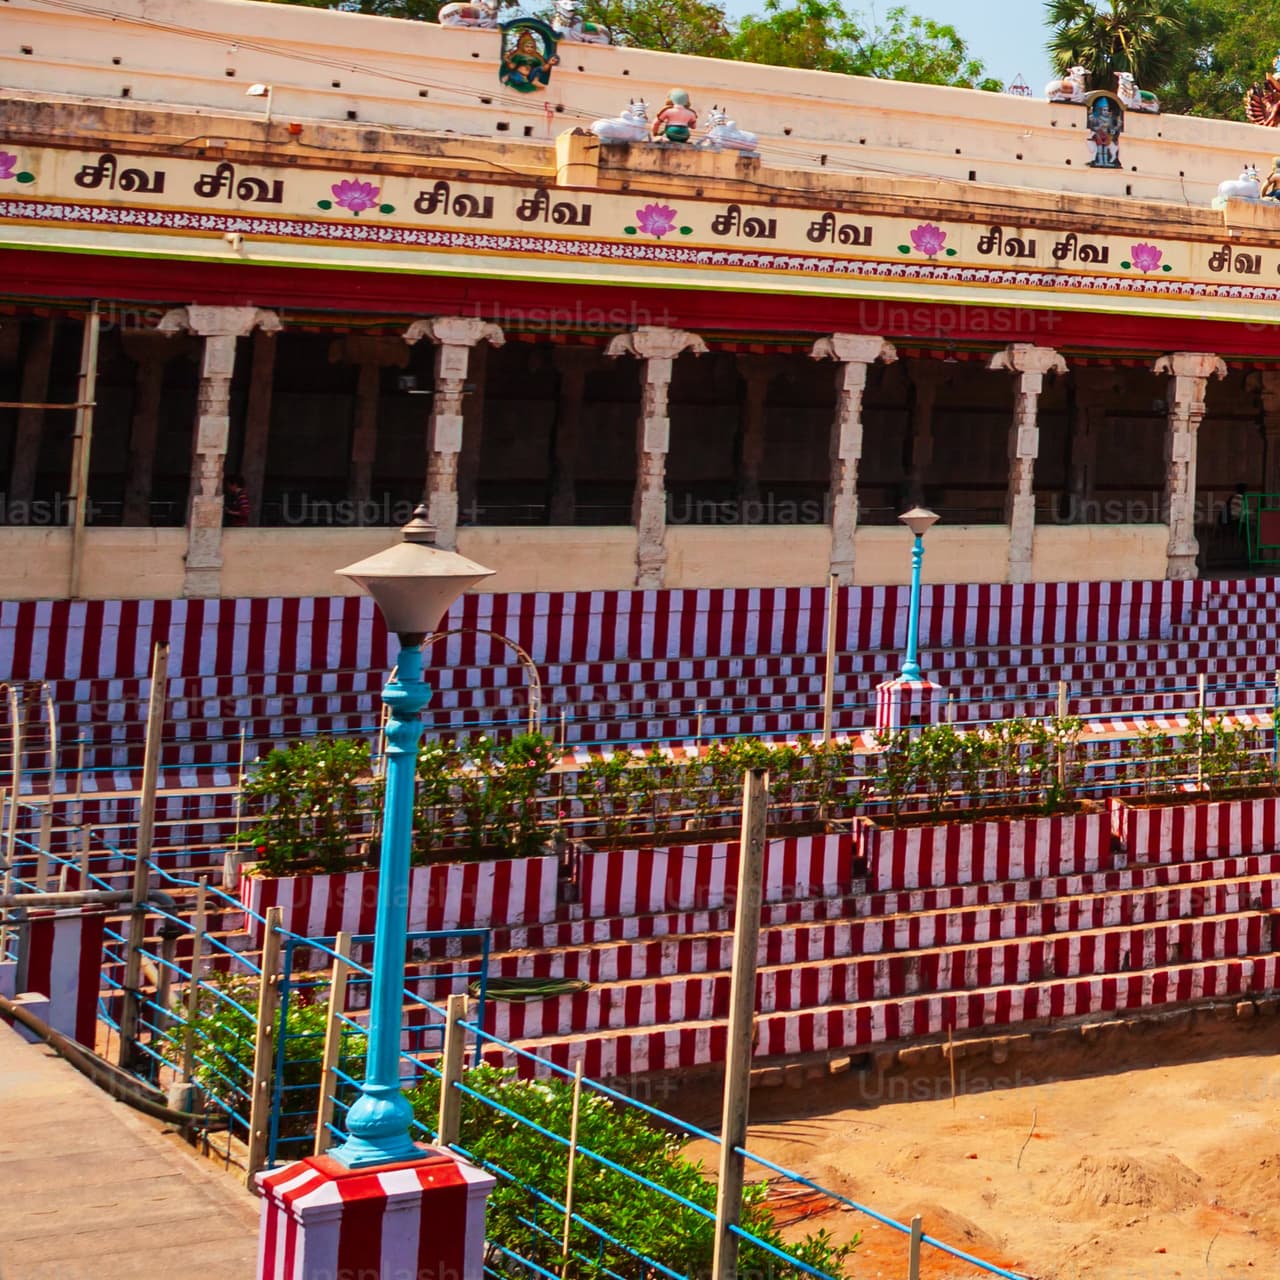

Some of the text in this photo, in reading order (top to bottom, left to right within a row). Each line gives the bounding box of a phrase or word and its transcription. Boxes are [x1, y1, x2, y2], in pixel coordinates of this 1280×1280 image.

[74, 155, 285, 203] சிவ சிவ
[414, 180, 592, 227] சிவ சிவ
[711, 203, 873, 247] சிவ சிவ
[977, 225, 1109, 265] சிவ சிவ
[1207, 246, 1261, 275] சிவ
